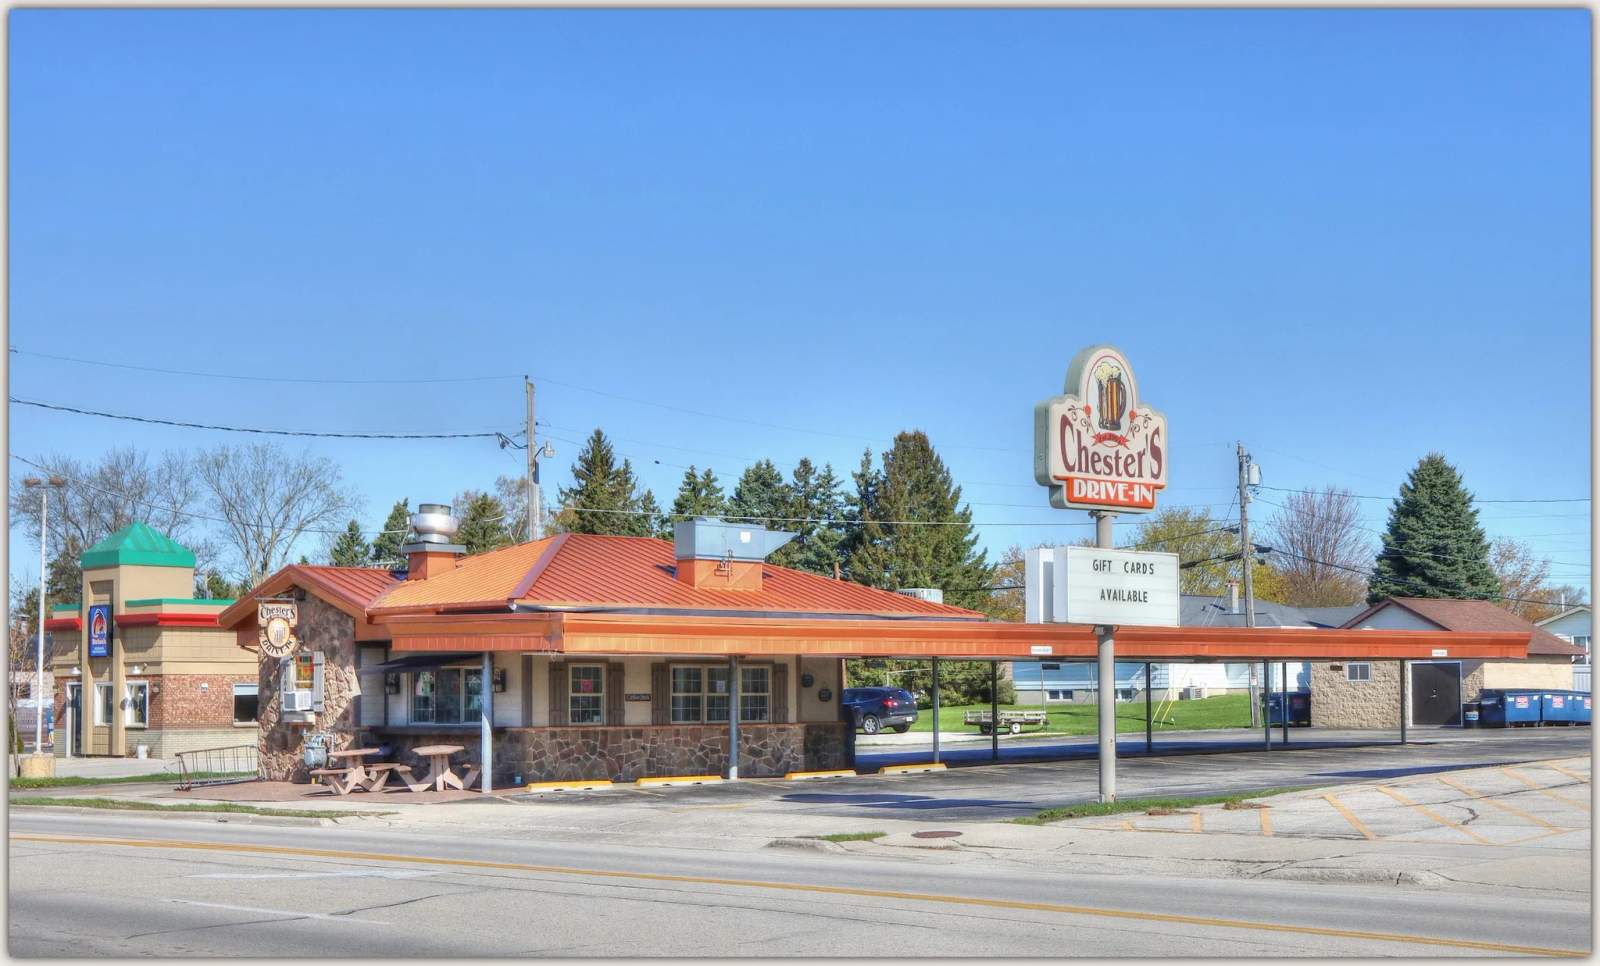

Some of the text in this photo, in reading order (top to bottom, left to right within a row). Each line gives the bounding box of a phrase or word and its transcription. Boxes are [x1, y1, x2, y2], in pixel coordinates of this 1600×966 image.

[1073, 479, 1152, 503] DRIVE-IN
[1093, 559, 1154, 575] GIFT CARDS
[1100, 588, 1148, 603] AVAILABLE
